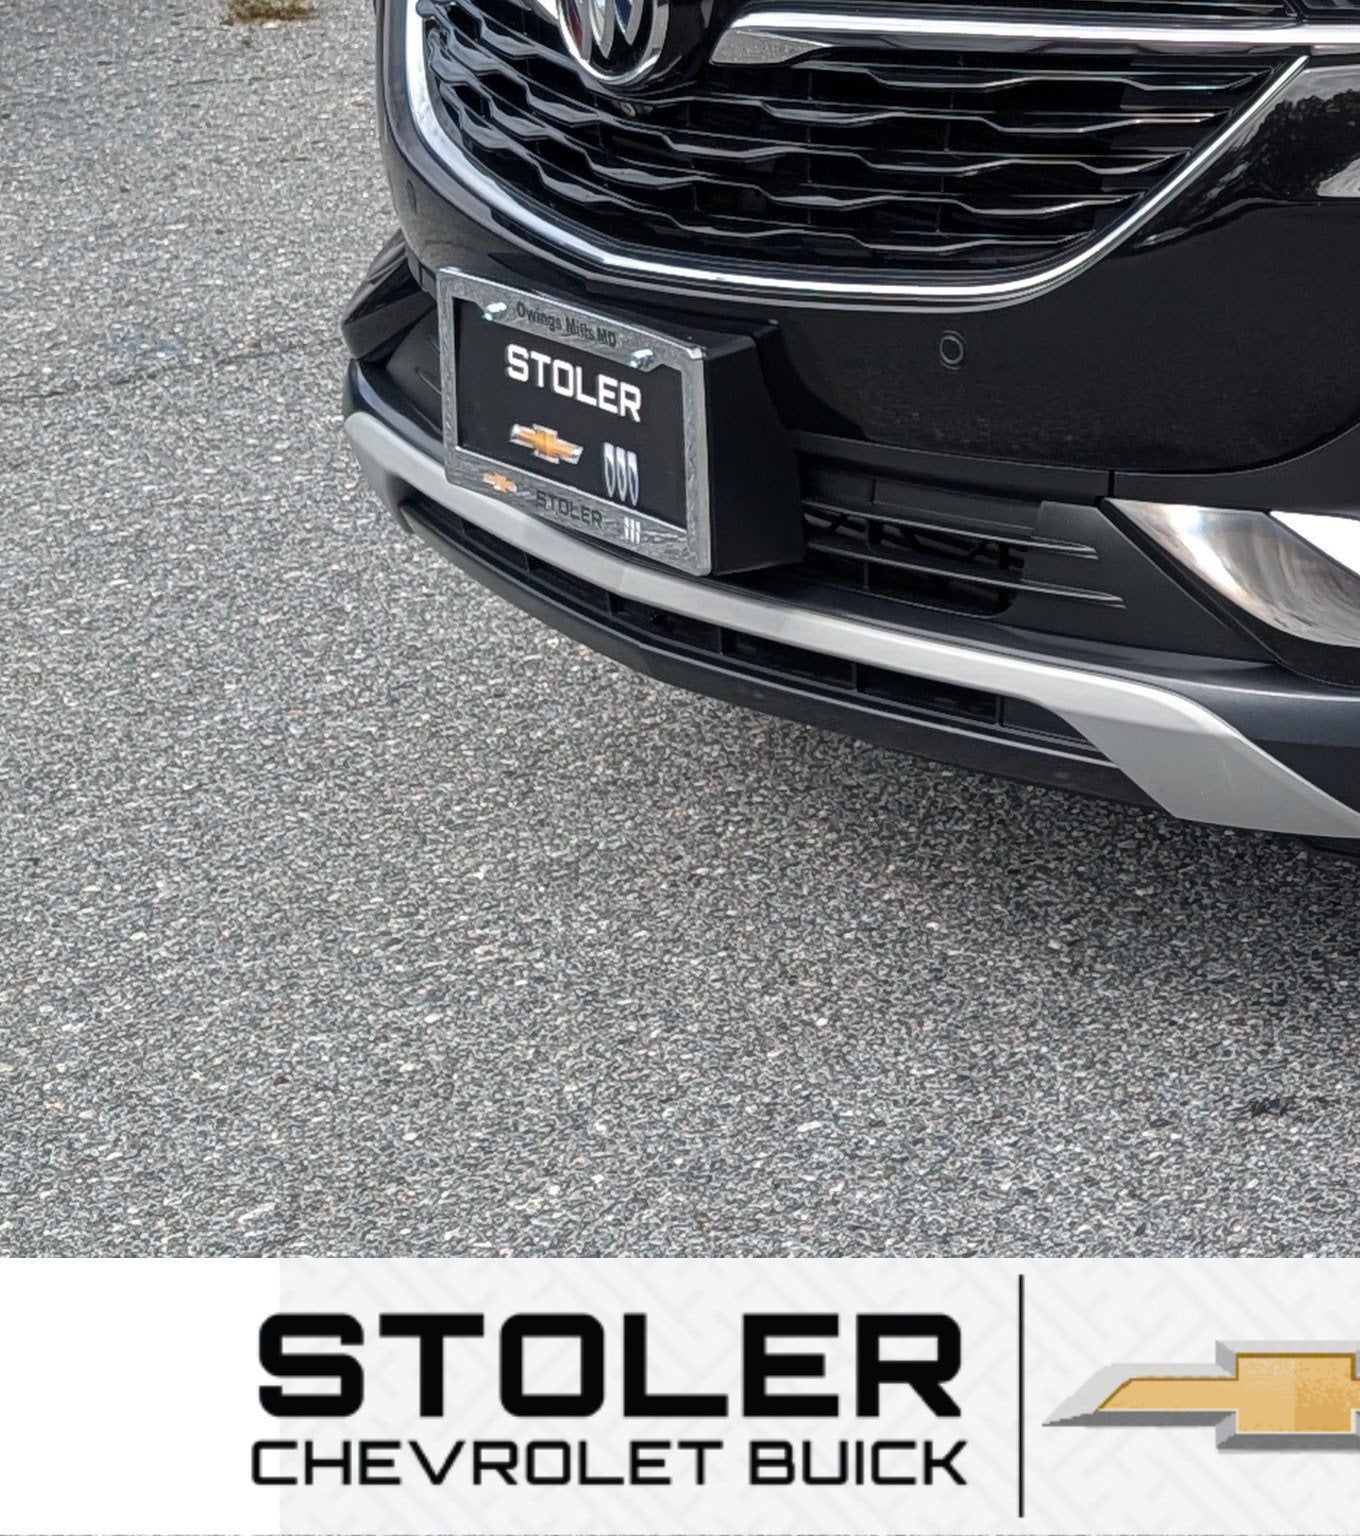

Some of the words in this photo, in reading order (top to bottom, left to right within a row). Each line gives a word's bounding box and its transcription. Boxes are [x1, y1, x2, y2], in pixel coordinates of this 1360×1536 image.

[516, 301, 562, 332] Owings
[506, 344, 641, 422] STOLER
[536, 489, 604, 530] STOLER
